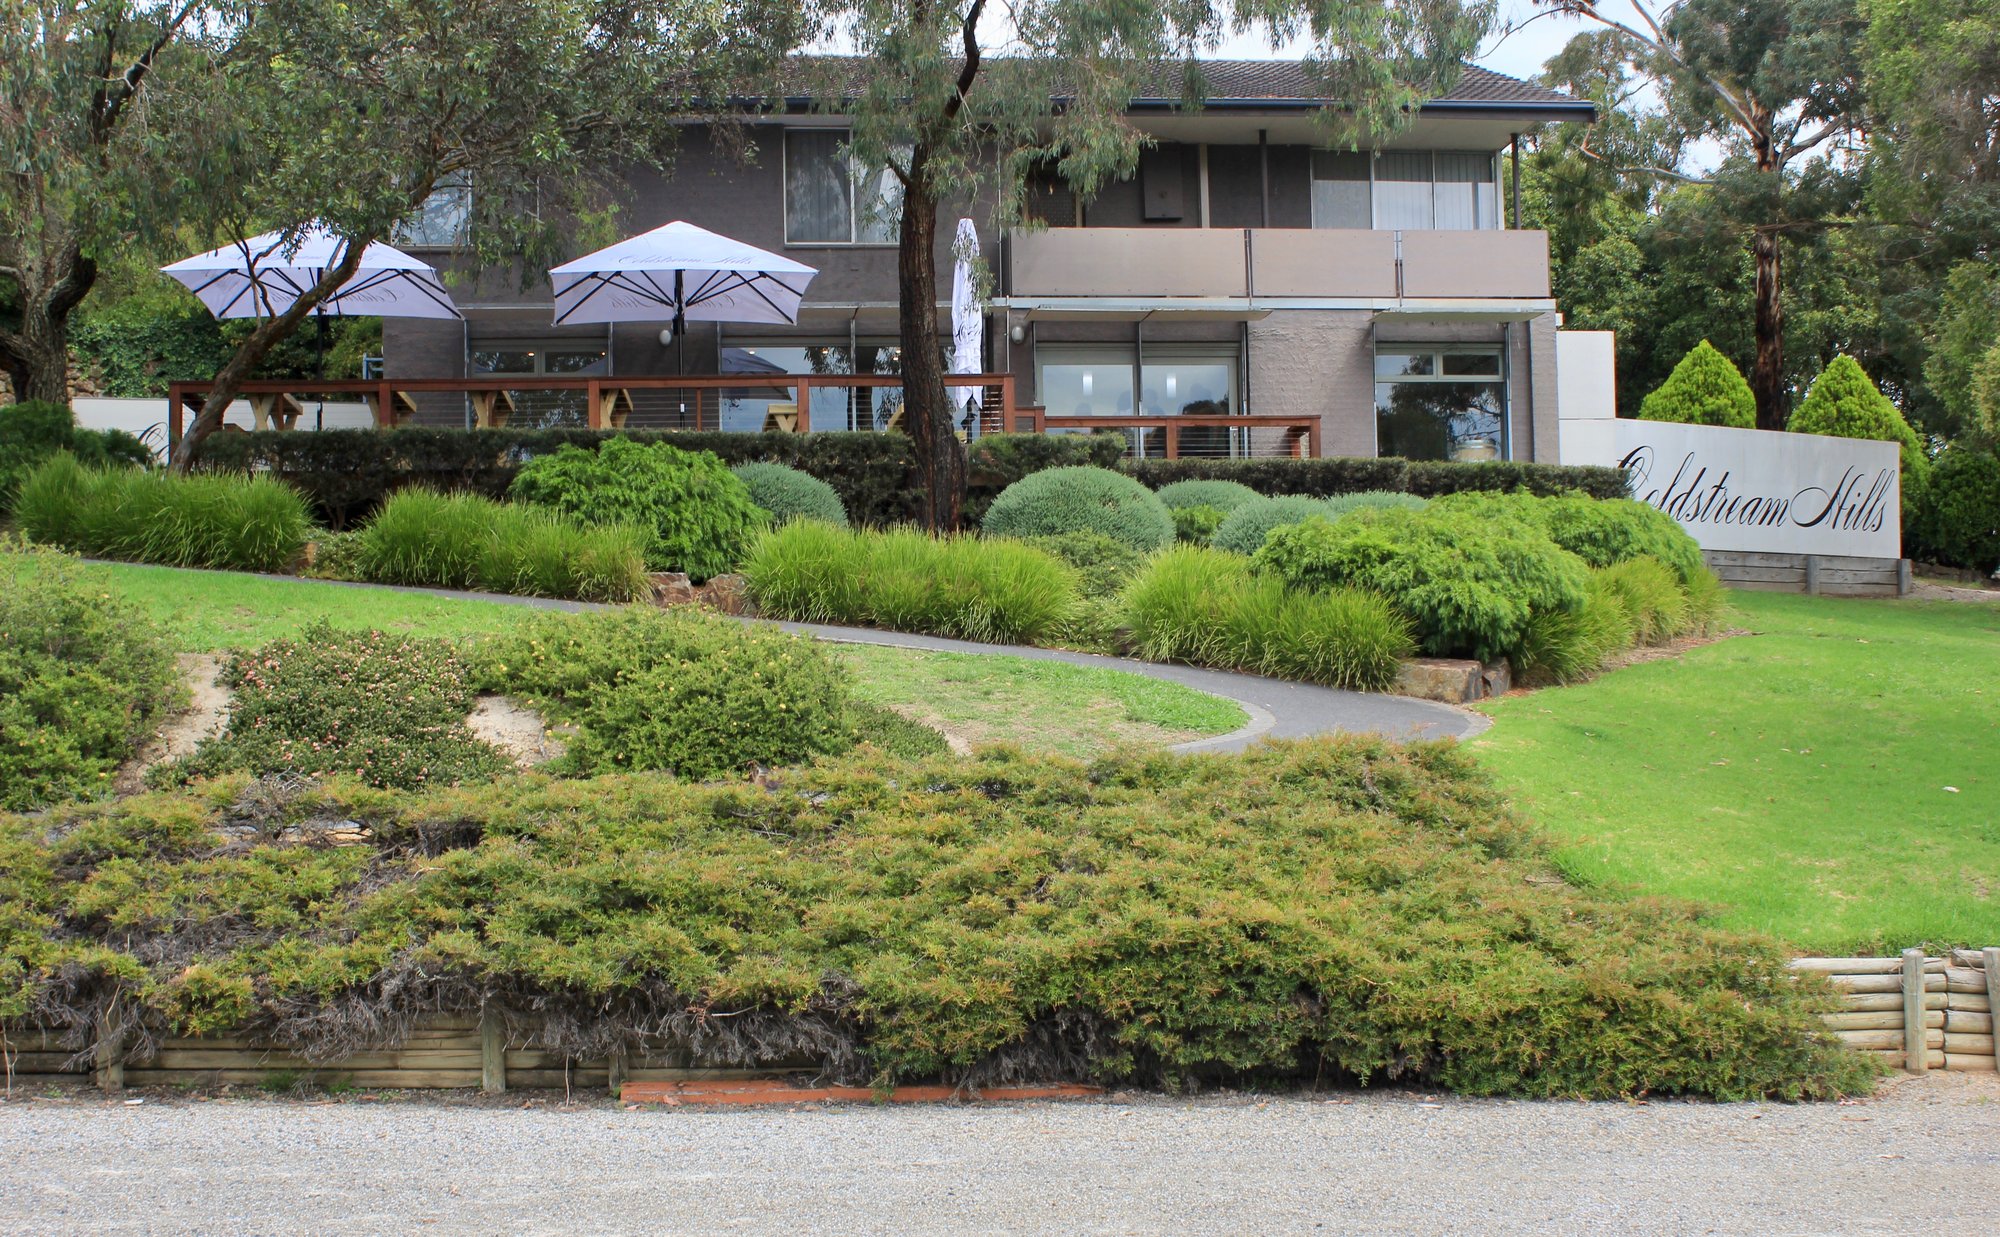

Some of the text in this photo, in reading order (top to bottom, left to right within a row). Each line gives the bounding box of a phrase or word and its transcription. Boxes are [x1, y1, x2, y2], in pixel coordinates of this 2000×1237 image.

[618, 254, 754, 266] Coldstream Hills
[1790, 464, 1895, 533] Hills
